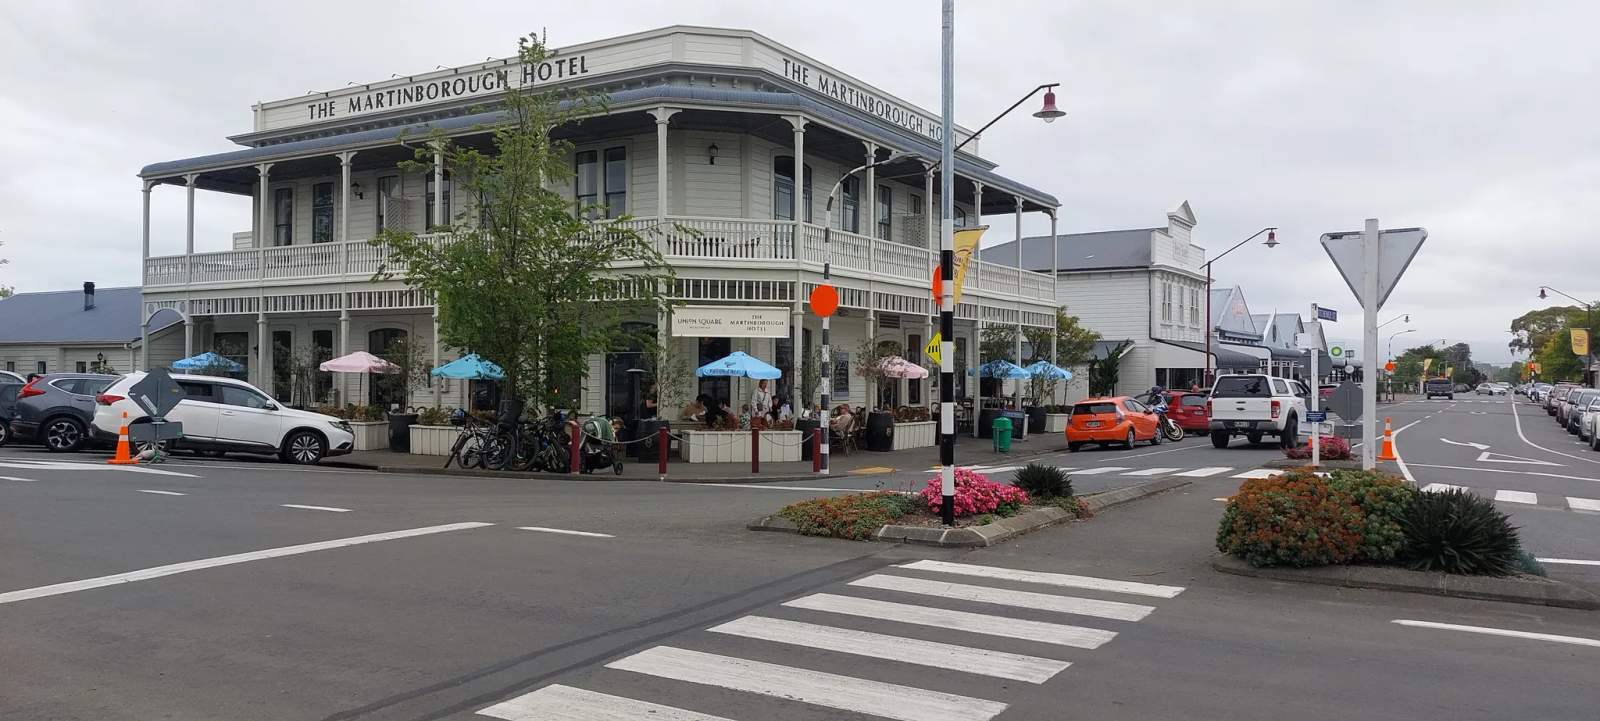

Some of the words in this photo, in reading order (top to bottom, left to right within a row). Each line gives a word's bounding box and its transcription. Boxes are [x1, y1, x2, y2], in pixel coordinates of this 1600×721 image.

[308, 101, 336, 119] THE
[348, 70, 508, 113] MARTINBOROUGH
[523, 55, 589, 84] HOTEL
[782, 57, 809, 86] THE
[818, 74, 923, 134] MARTINBOROUGH
[698, 318, 722, 326] SQUARE
